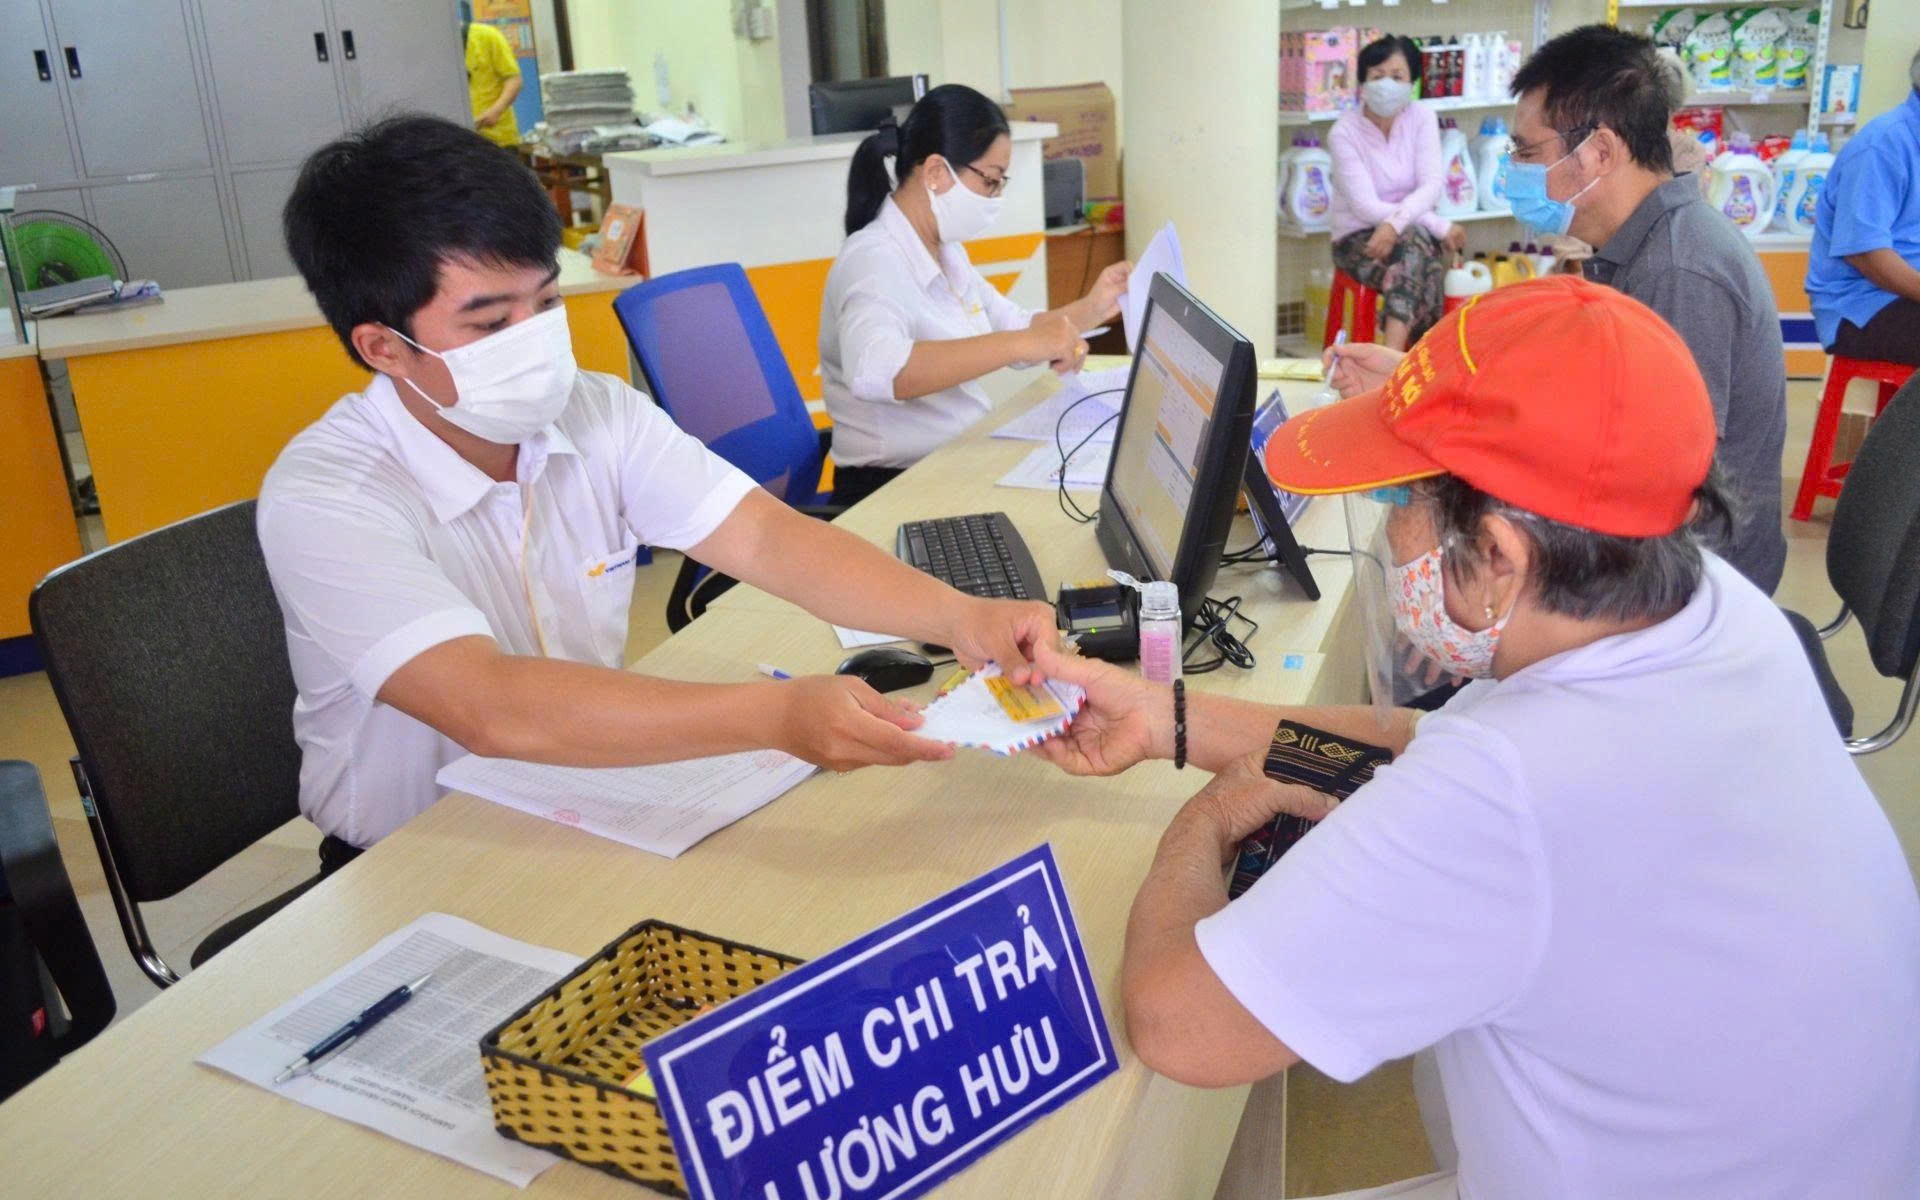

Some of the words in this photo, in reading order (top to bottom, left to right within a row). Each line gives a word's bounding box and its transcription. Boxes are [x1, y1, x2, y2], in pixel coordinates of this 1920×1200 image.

[706, 1026, 854, 1159] ĐIỂM
[862, 977, 953, 1068] CHI
[954, 904, 1057, 1012] TRẢ
[959, 1016, 1060, 1118] HƯU
